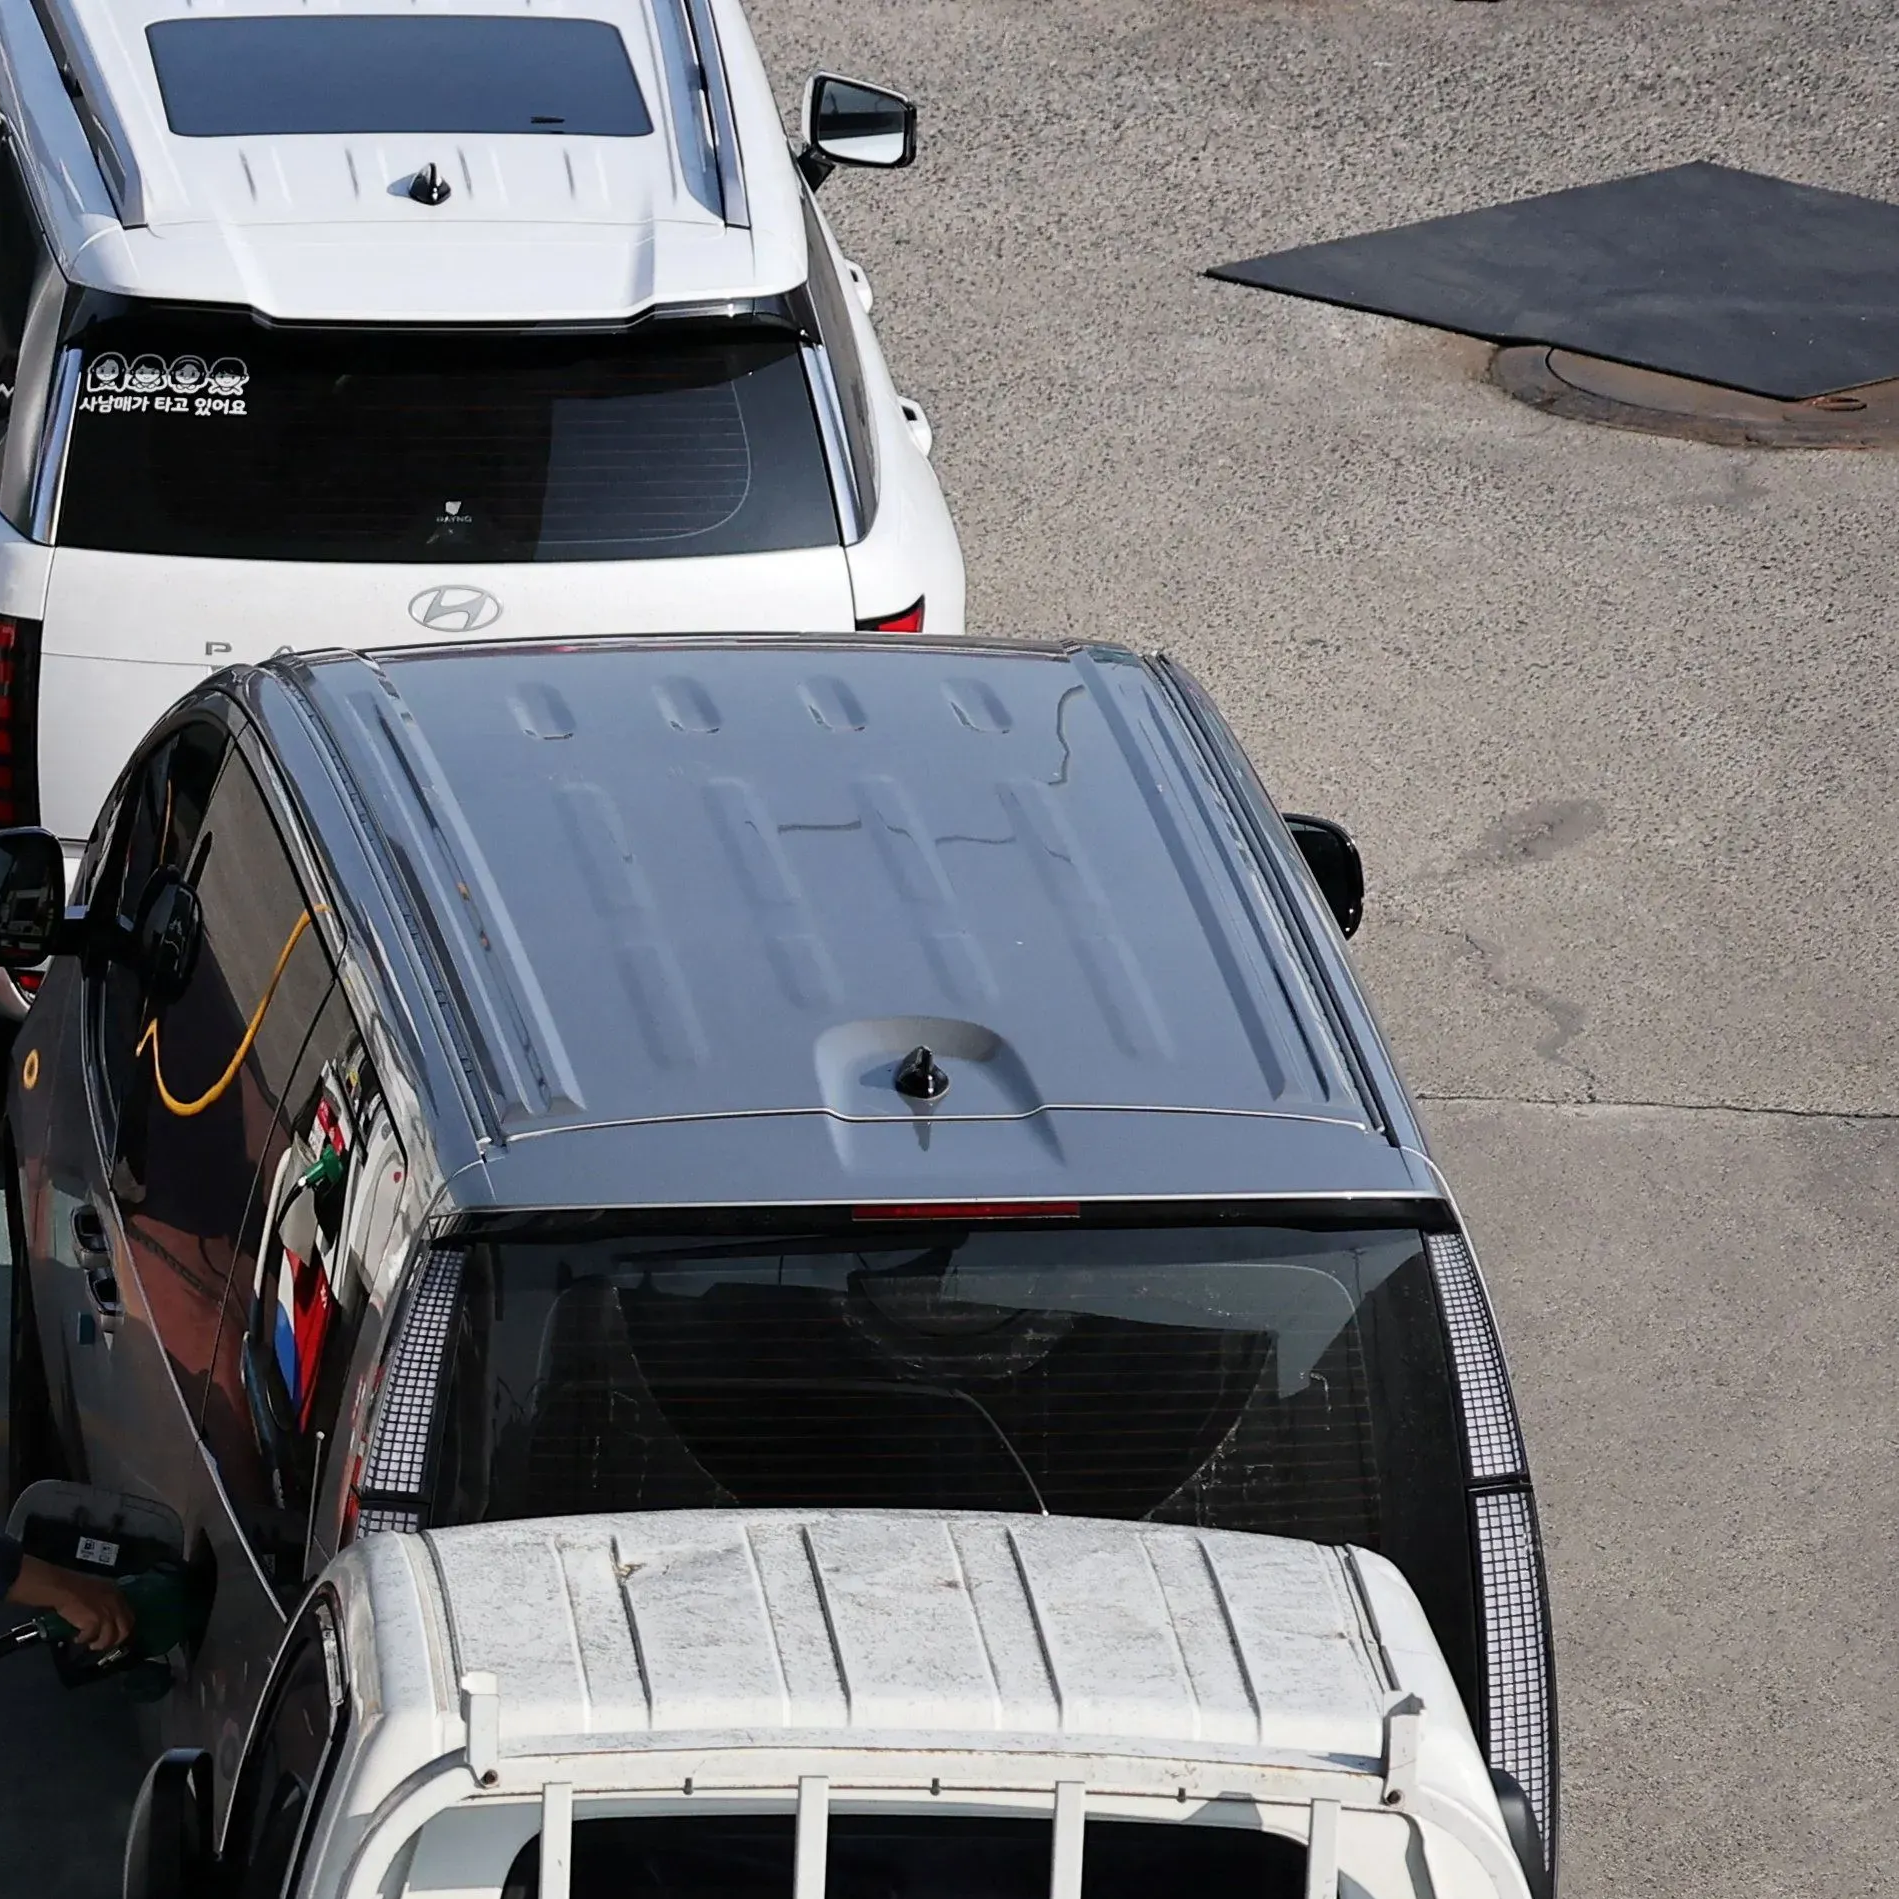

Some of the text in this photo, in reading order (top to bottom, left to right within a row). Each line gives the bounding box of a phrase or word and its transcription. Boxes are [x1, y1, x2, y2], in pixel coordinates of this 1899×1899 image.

[79, 395, 248, 416] 사남매가 타고 있어요
